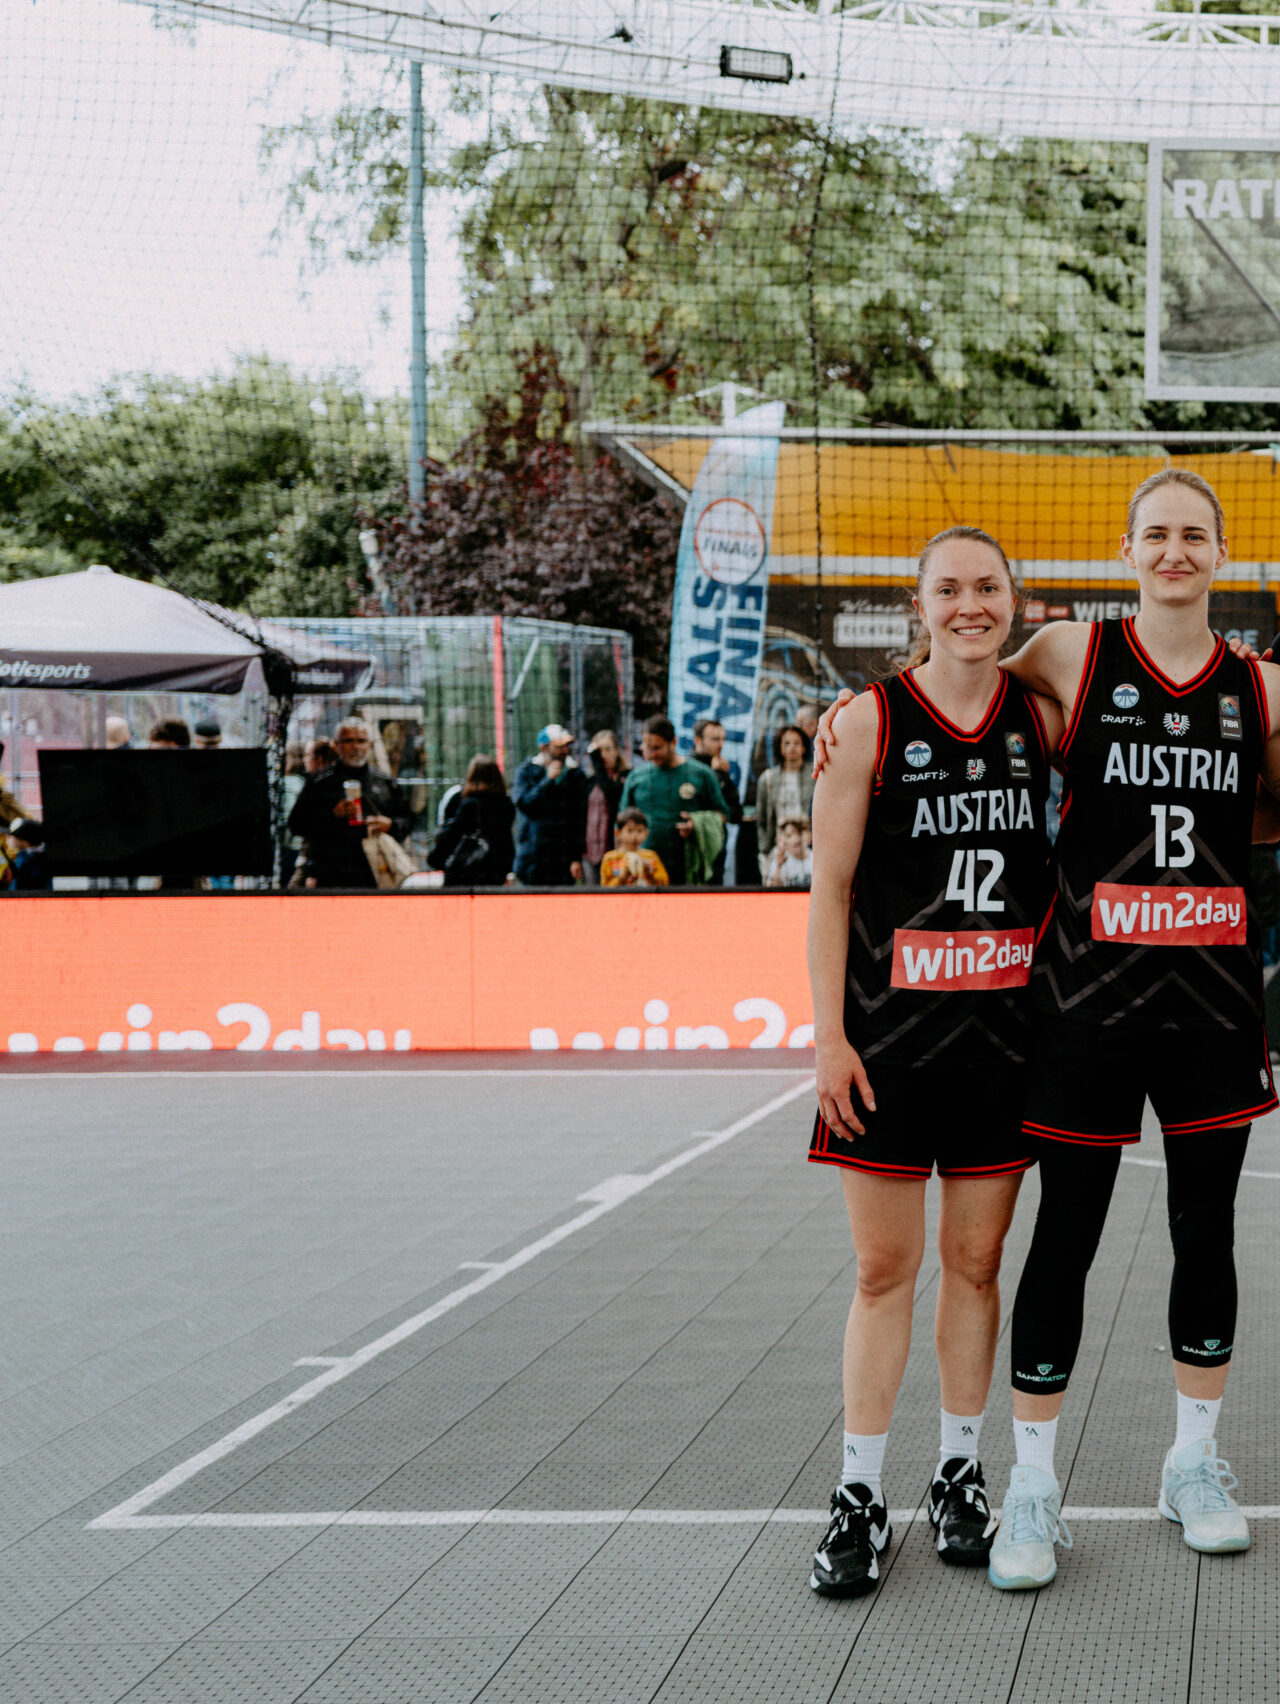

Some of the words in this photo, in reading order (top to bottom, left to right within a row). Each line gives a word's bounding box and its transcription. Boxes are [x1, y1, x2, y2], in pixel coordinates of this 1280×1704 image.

[1101, 714, 1135, 725] CRAFT
[1222, 719, 1239, 728] FIBA
[902, 771, 939, 782] CRAFT
[1011, 758, 1026, 767] FIBA
[1103, 742, 1239, 793] AUSTRIA
[911, 788, 1034, 838] AUSTRIA
[1150, 804, 1195, 868] 13
[945, 849, 1005, 912] 42
[1099, 891, 1241, 936] win2day
[902, 936, 1034, 984] win2day
[1016, 1371, 1067, 1382] GAMEPATCH
